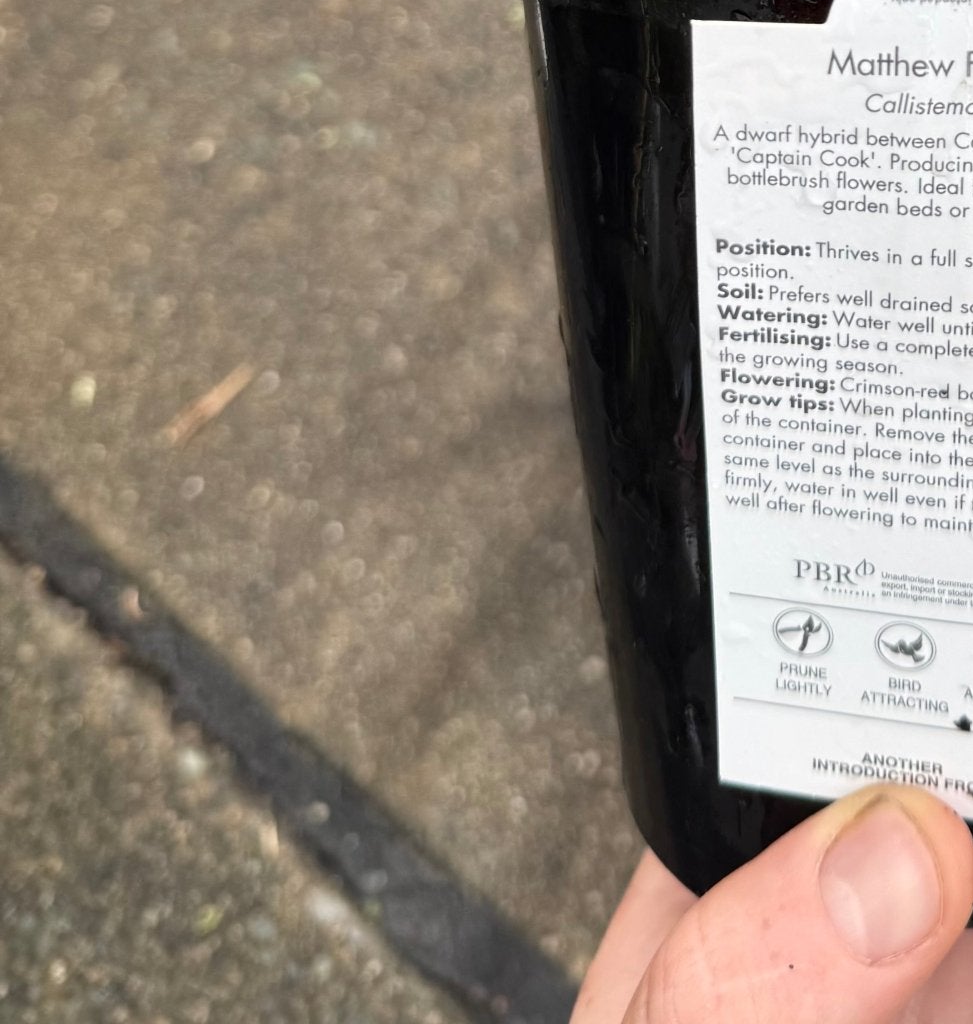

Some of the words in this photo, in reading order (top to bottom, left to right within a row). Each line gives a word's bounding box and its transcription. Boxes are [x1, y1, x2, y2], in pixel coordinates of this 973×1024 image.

[827, 45, 955, 78] Matthew
[713, 124, 730, 141] A
[735, 123, 792, 142] dwarf
[798, 125, 858, 149] hybrid
[866, 127, 946, 149] between
[731, 146, 812, 169] 'Captain
[819, 149, 882, 169] Cook'.
[727, 166, 829, 189] bottlebrush
[836, 171, 908, 194] flowers.
[918, 176, 964, 195] Ideal
[822, 194, 889, 215] garden
[897, 197, 942, 217] beds
[949, 206, 970, 218] or
[715, 238, 811, 258] Position:
[815, 241, 879, 262] Thrives
[887, 248, 902, 265] in
[911, 254, 923, 266] a
[930, 248, 956, 267] full
[717, 263, 794, 281] position.
[717, 283, 763, 300] Soil:
[769, 285, 830, 304] Prefers
[836, 289, 873, 307] well
[880, 292, 952, 313] drained
[717, 304, 827, 329] Watering:
[832, 310, 891, 331] Water
[897, 316, 934, 334] well
[719, 326, 831, 351] Fertilising:
[837, 332, 870, 350] Use
[876, 341, 888, 352] a
[719, 346, 746, 363] the
[753, 353, 828, 373] growing
[836, 360, 903, 375] season.
[720, 368, 835, 394] Flowering:
[840, 376, 950, 400] Crimson-red
[721, 389, 782, 407] Grow
[789, 393, 834, 414] tips:
[839, 397, 894, 417] When
[722, 409, 739, 424] of
[745, 410, 772, 427] the
[778, 419, 867, 436] container.
[875, 422, 945, 443] Remove
[723, 434, 805, 452] container
[811, 439, 846, 456] and
[853, 441, 902, 461] place
[909, 448, 942, 465] into
[724, 455, 769, 469] same
[776, 454, 815, 474] level
[822, 465, 842, 477] as
[849, 462, 875, 480] the
[725, 469, 777, 493] firmly,
[785, 481, 834, 496] water
[841, 484, 856, 499] in
[863, 487, 898, 503] well
[905, 495, 946, 509] even
[954, 494, 965, 511] if
[725, 492, 759, 508] well
[766, 495, 806, 514] after
[812, 499, 893, 528] flowering
[901, 512, 917, 526] to
[793, 558, 858, 585] PBR
[780, 662, 828, 679] PRUNE
[775, 678, 832, 697] LIGHTLY
[888, 677, 921, 693] BIRD
[860, 691, 949, 713] ATTRACTING
[812, 757, 939, 787] INTRODUCTION
[861, 752, 943, 775] ANOTHER
